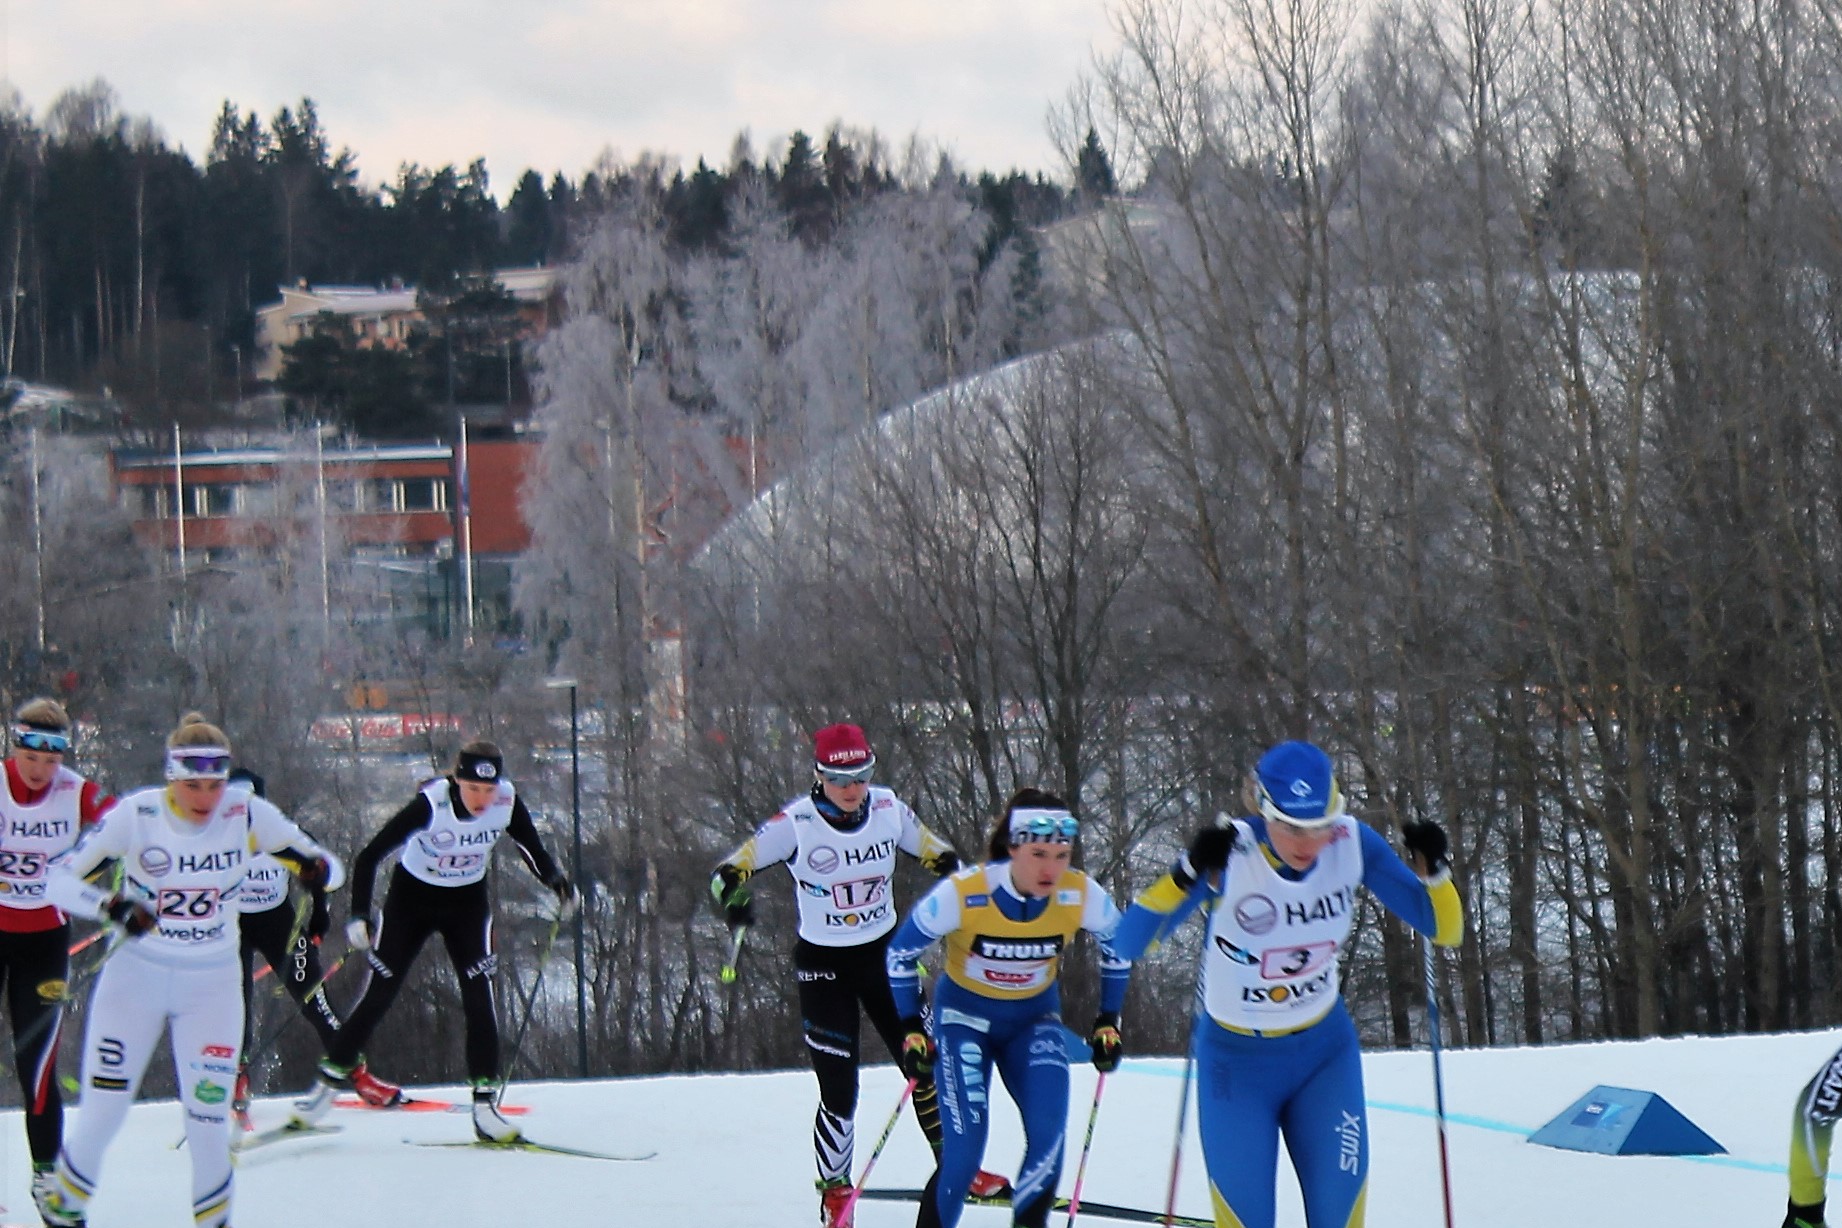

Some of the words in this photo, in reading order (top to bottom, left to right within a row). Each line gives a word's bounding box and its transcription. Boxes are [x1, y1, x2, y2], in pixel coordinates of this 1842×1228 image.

[12, 821, 68, 837] HALTI
[460, 829, 500, 847] HALT
[0, 851, 39, 876] 25
[179, 850, 242, 874] HALTI
[162, 891, 213, 917] 26
[842, 881, 881, 906] 17
[160, 923, 225, 940] weber
[981, 942, 1058, 959] THULE
[1281, 949, 1311, 975] 3
[1335, 1110, 1361, 1176] swix
